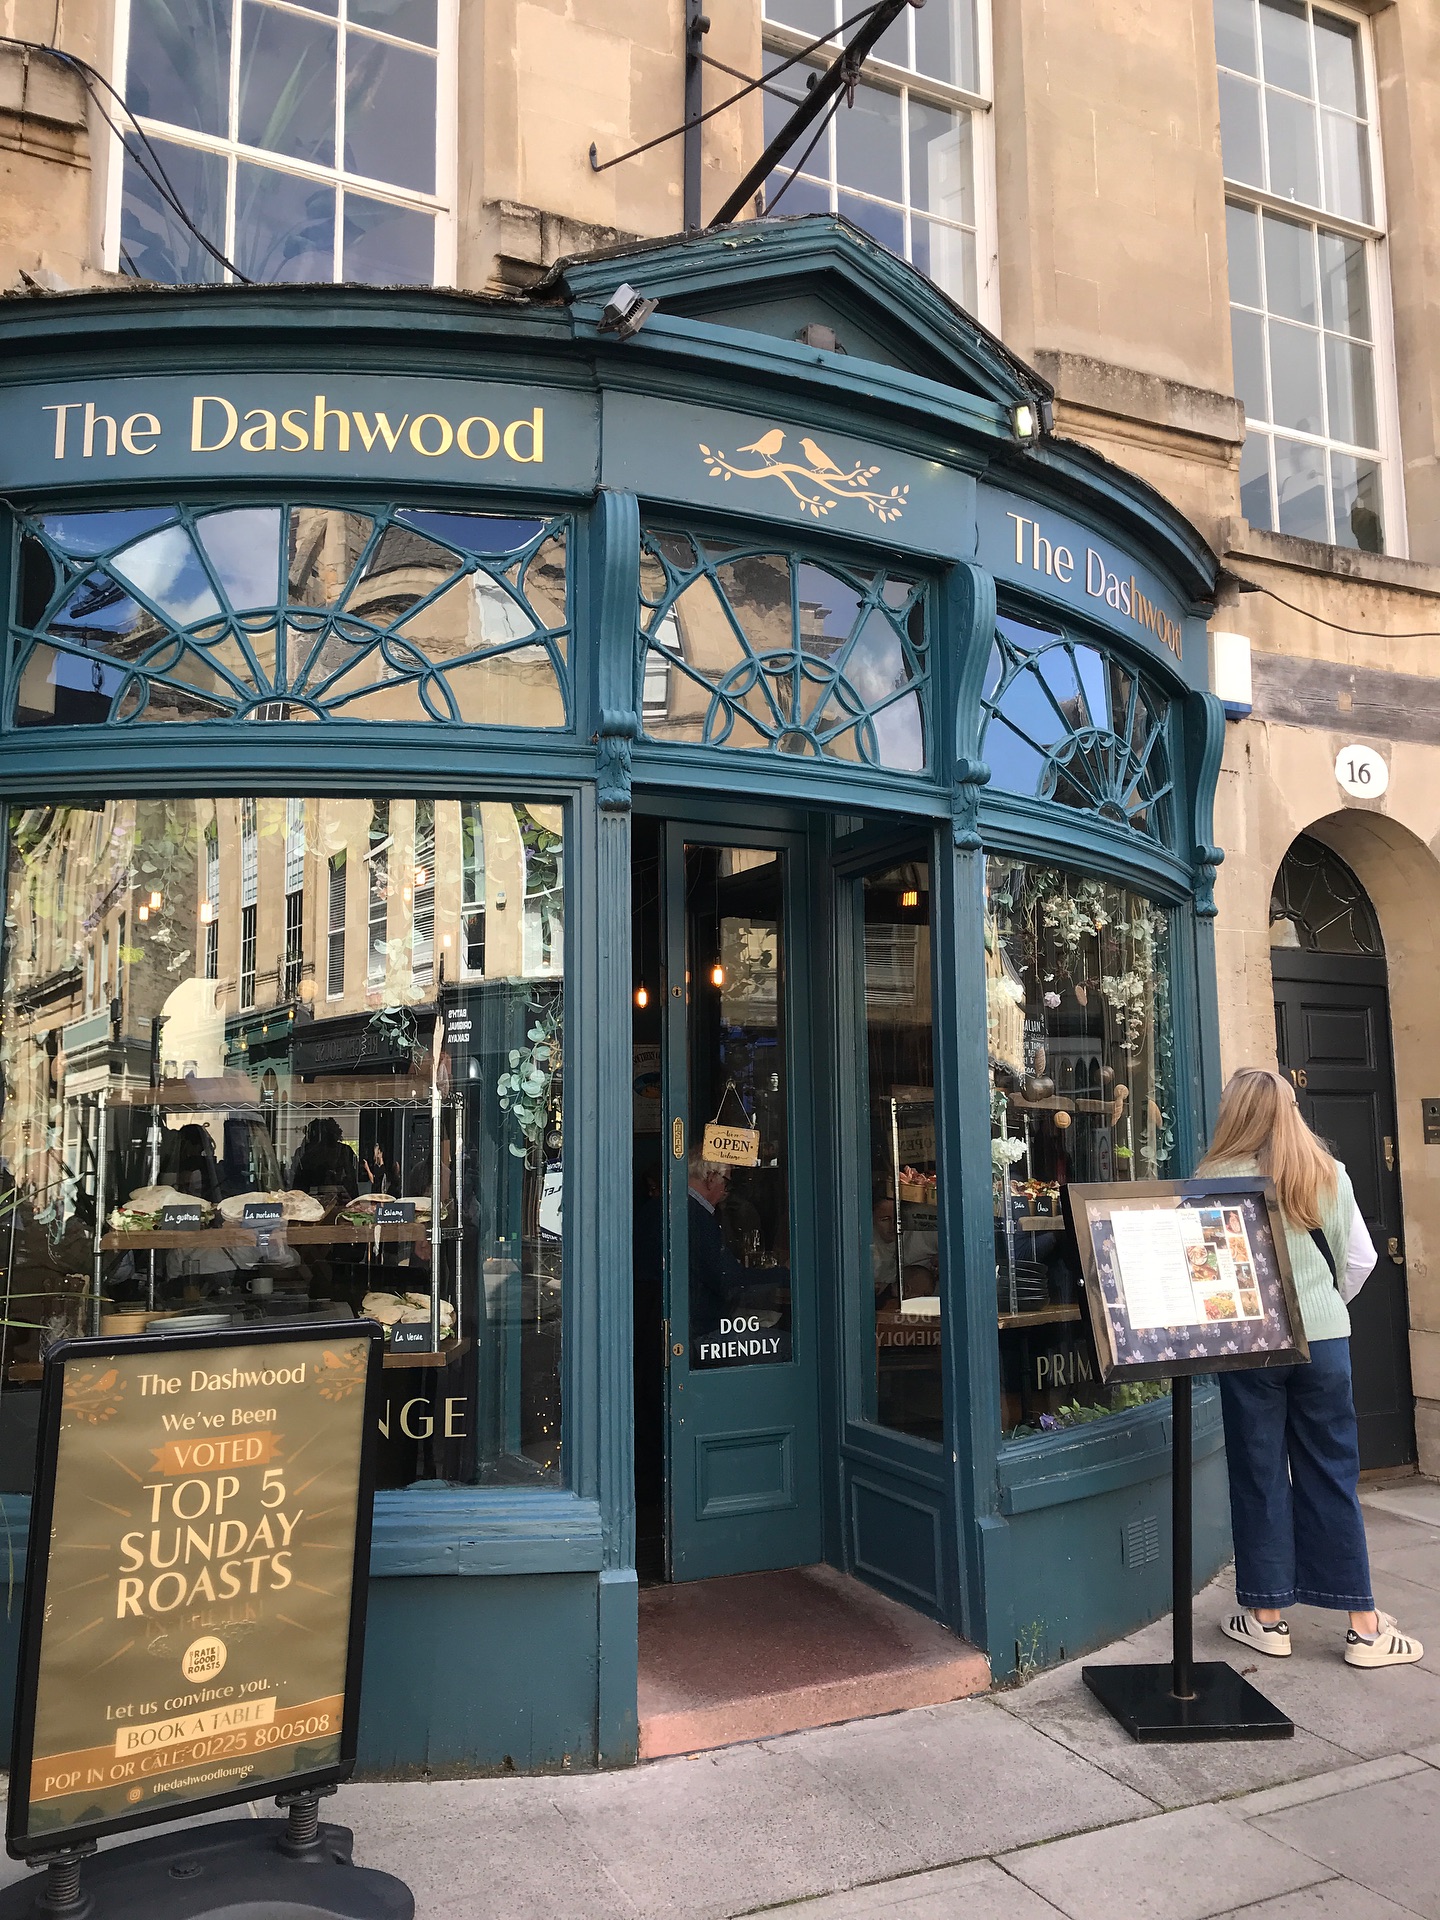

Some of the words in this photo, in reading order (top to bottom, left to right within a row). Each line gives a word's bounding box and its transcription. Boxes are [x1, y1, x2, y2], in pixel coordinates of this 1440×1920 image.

[42, 402, 161, 460] The
[190, 395, 544, 463] Dashwood
[1006, 511, 1074, 583] The
[1085, 547, 1183, 662] Dashwood
[1346, 759, 1371, 785] 16
[1290, 1069, 1308, 1089] 16
[713, 1136, 751, 1153] OPEN
[164, 1213, 175, 1222] La
[245, 1210, 254, 1219] La
[394, 1331, 404, 1342] La
[720, 1315, 760, 1335] DOG
[700, 1337, 781, 1360] FRIENDLY
[137, 1374, 182, 1396] The
[190, 1362, 306, 1392] Dashwood
[162, 1411, 226, 1432] We've
[231, 1407, 277, 1426] Been
[173, 1437, 263, 1469] VOTED
[143, 1475, 240, 1523] TOP
[260, 1468, 287, 1509] 5
[119, 1509, 304, 1573] SUNDAY
[116, 1551, 293, 1619] ROASTS
[193, 1654, 216, 1665] GOOD
[194, 1646, 216, 1658] RATE
[188, 1660, 221, 1674] ROASTS
[106, 1704, 134, 1721] Let
[139, 1702, 158, 1716] us
[164, 1685, 234, 1712] convince
[126, 1722, 186, 1750] BOOK
[191, 1717, 206, 1734] A
[209, 1703, 267, 1731] TABLE
[44, 1771, 81, 1793] POP
[86, 1766, 105, 1785] IN
[110, 1760, 135, 1780] OR
[191, 1731, 248, 1760] 01225
[254, 1713, 331, 1747] 800508
[153, 1762, 255, 1794] thedashwoodlounge
